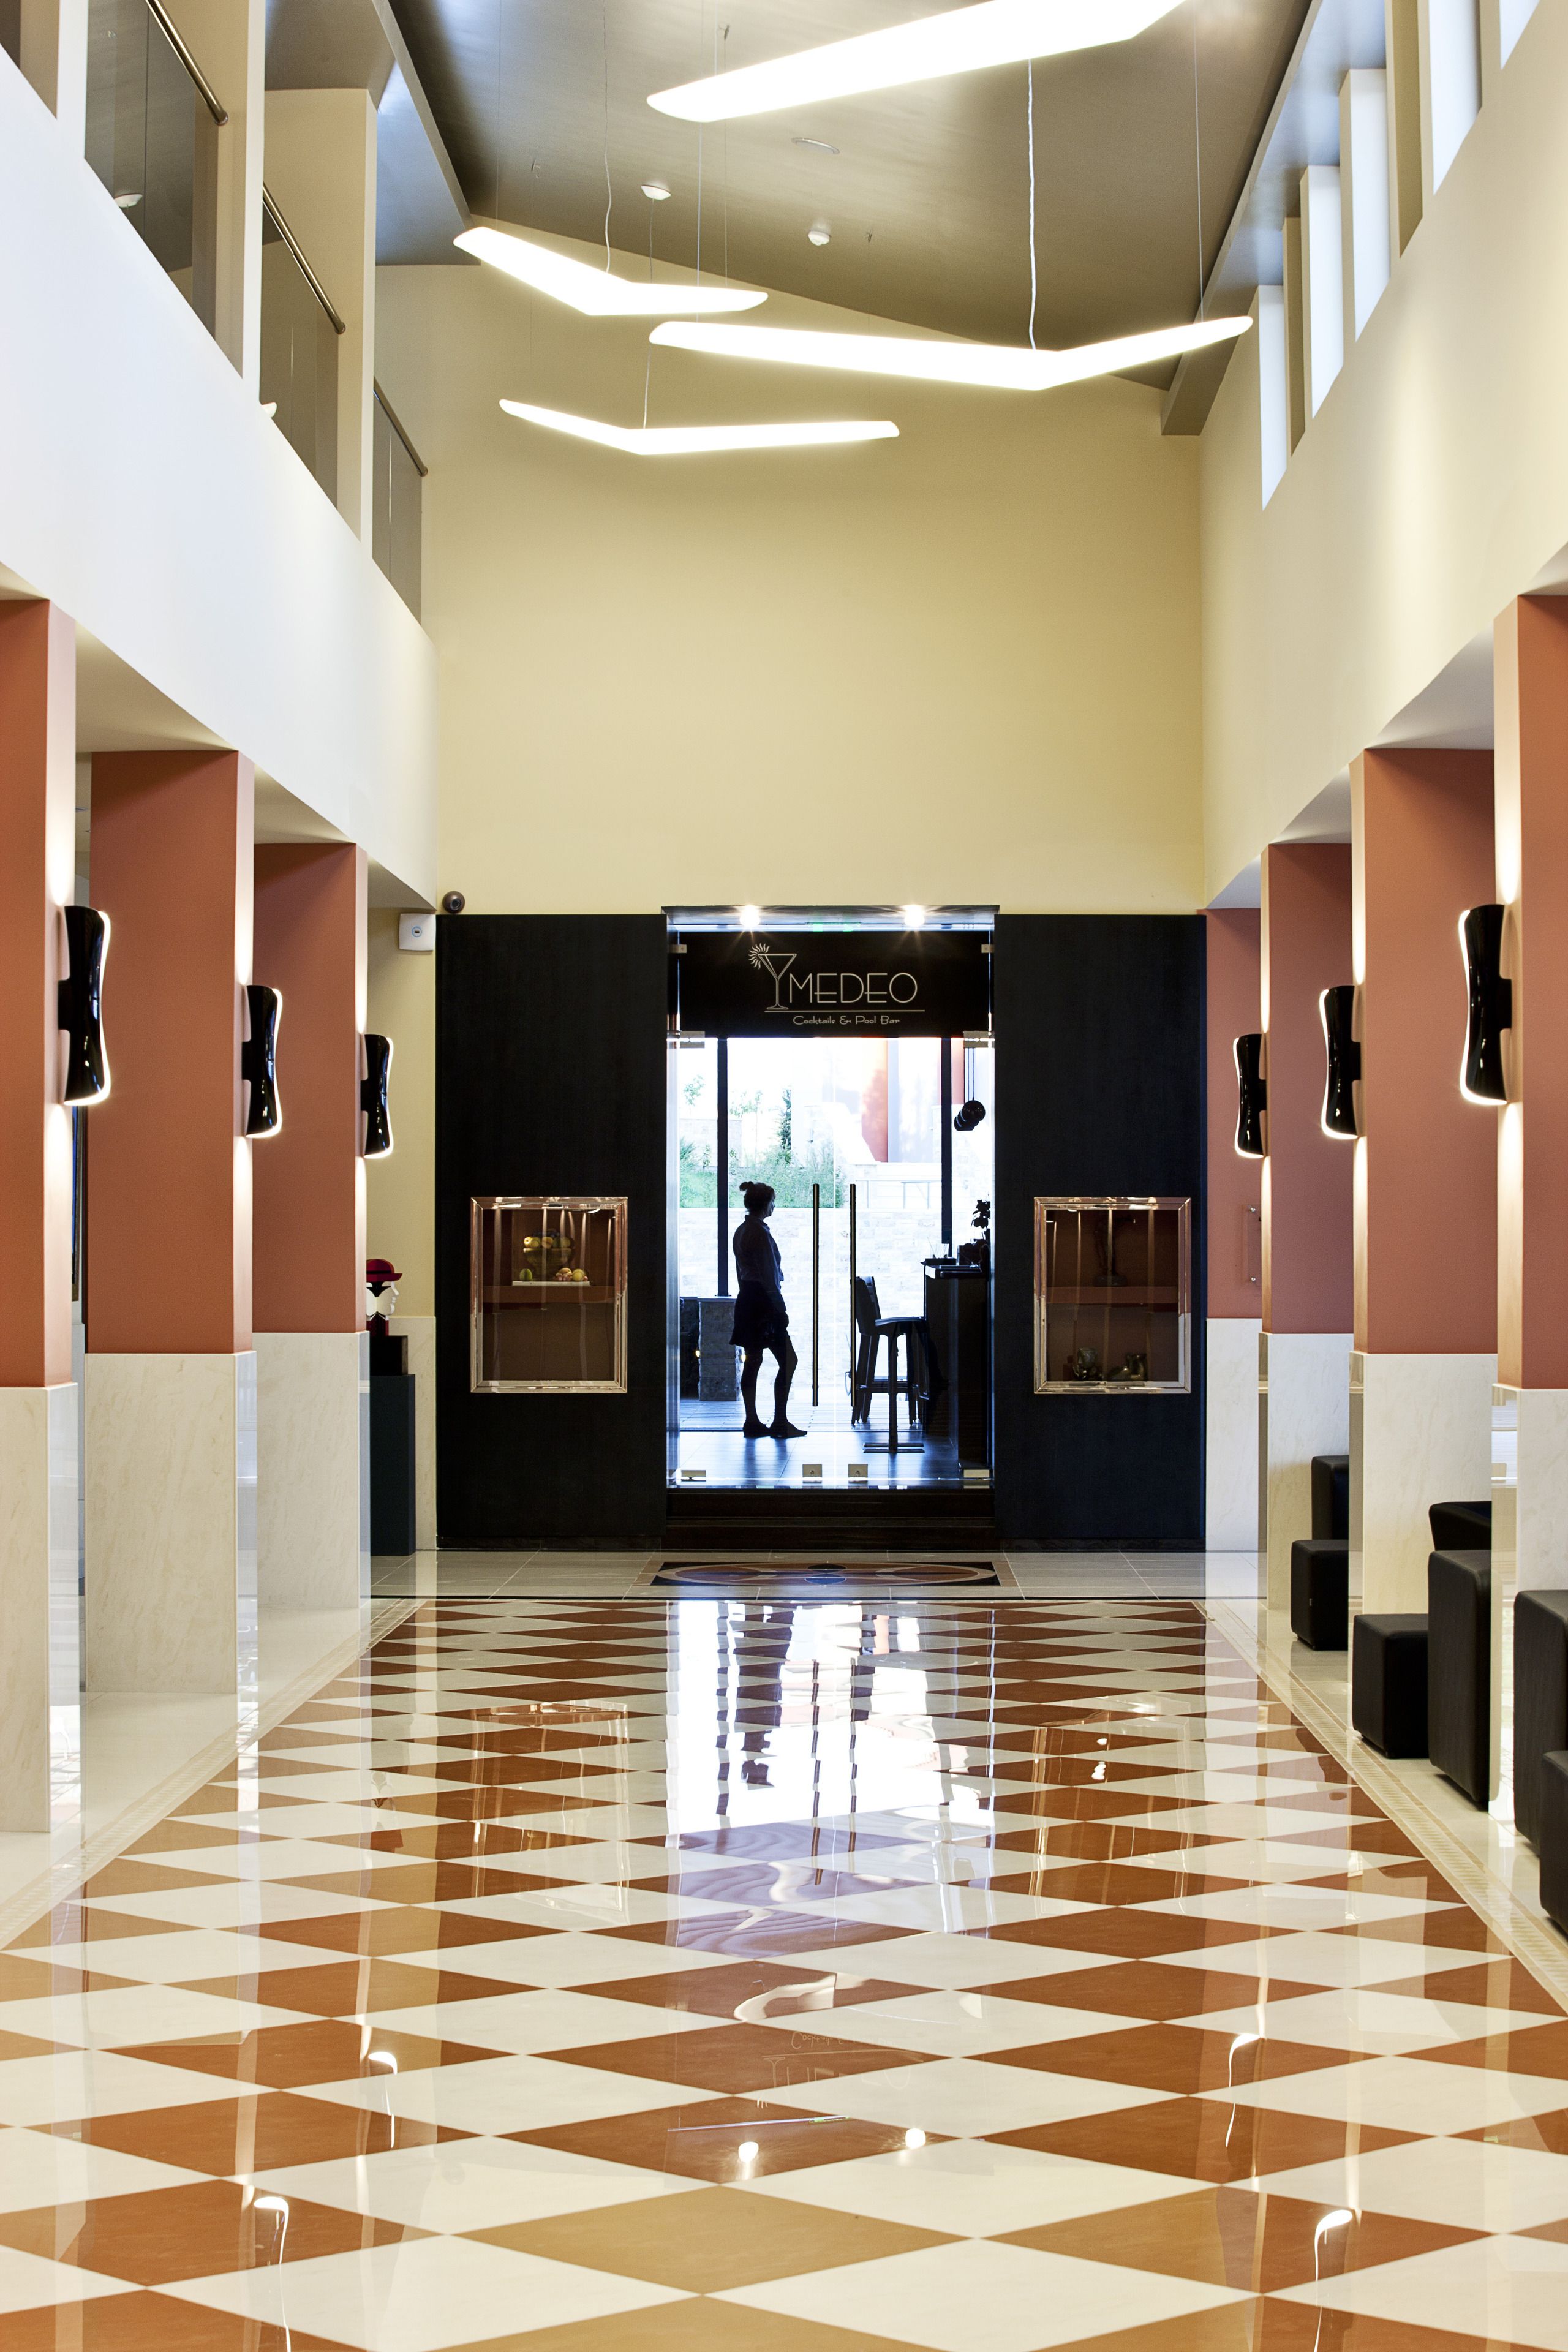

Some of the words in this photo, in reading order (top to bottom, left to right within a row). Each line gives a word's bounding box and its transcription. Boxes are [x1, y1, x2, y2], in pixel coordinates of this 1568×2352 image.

[793, 1015, 835, 1025] Cocktails
[839, 1015, 851, 1025] &
[855, 1015, 876, 1025] Pool
[880, 1015, 900, 1025] Bar
